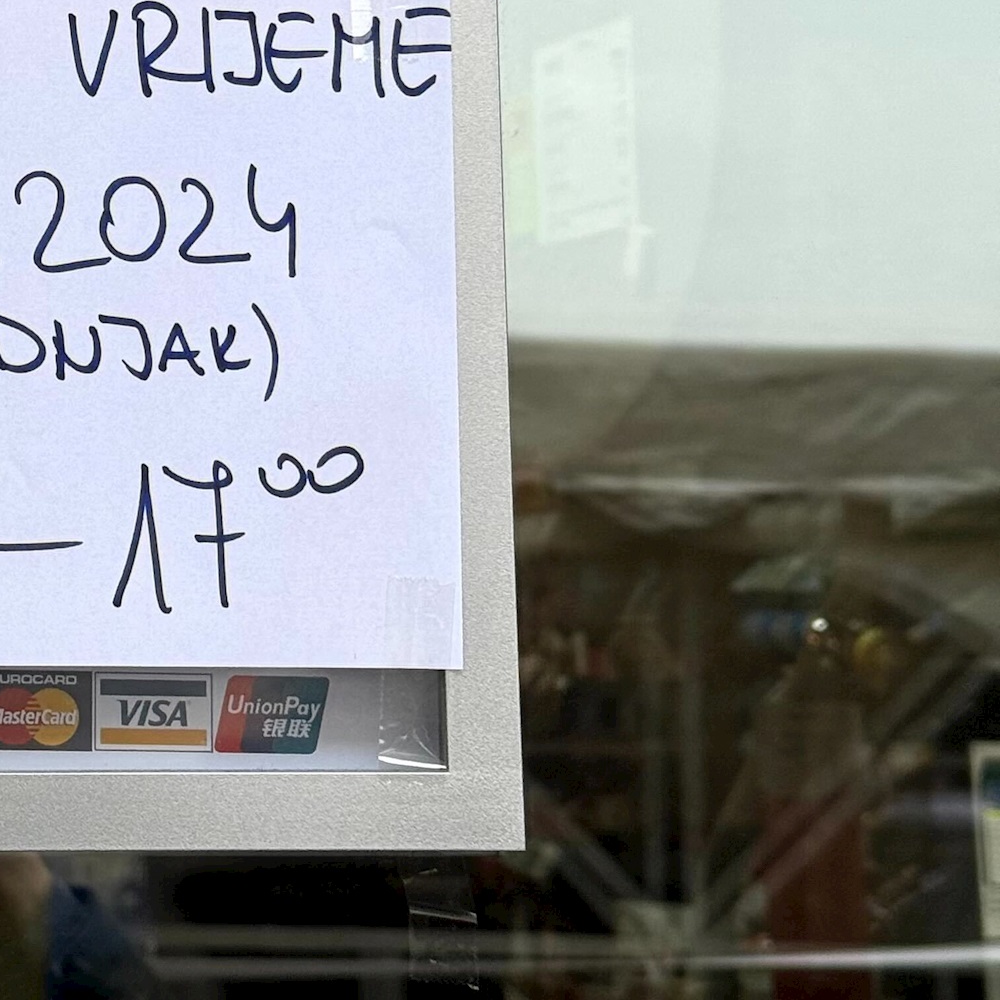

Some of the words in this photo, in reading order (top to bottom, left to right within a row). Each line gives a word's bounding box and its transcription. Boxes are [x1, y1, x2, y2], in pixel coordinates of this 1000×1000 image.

[68, 1, 452, 98] VRIJEME
[116, 699, 188, 726] VISA
[227, 694, 321, 722] UnionPay
[262, 718, 312, 738] 银联
